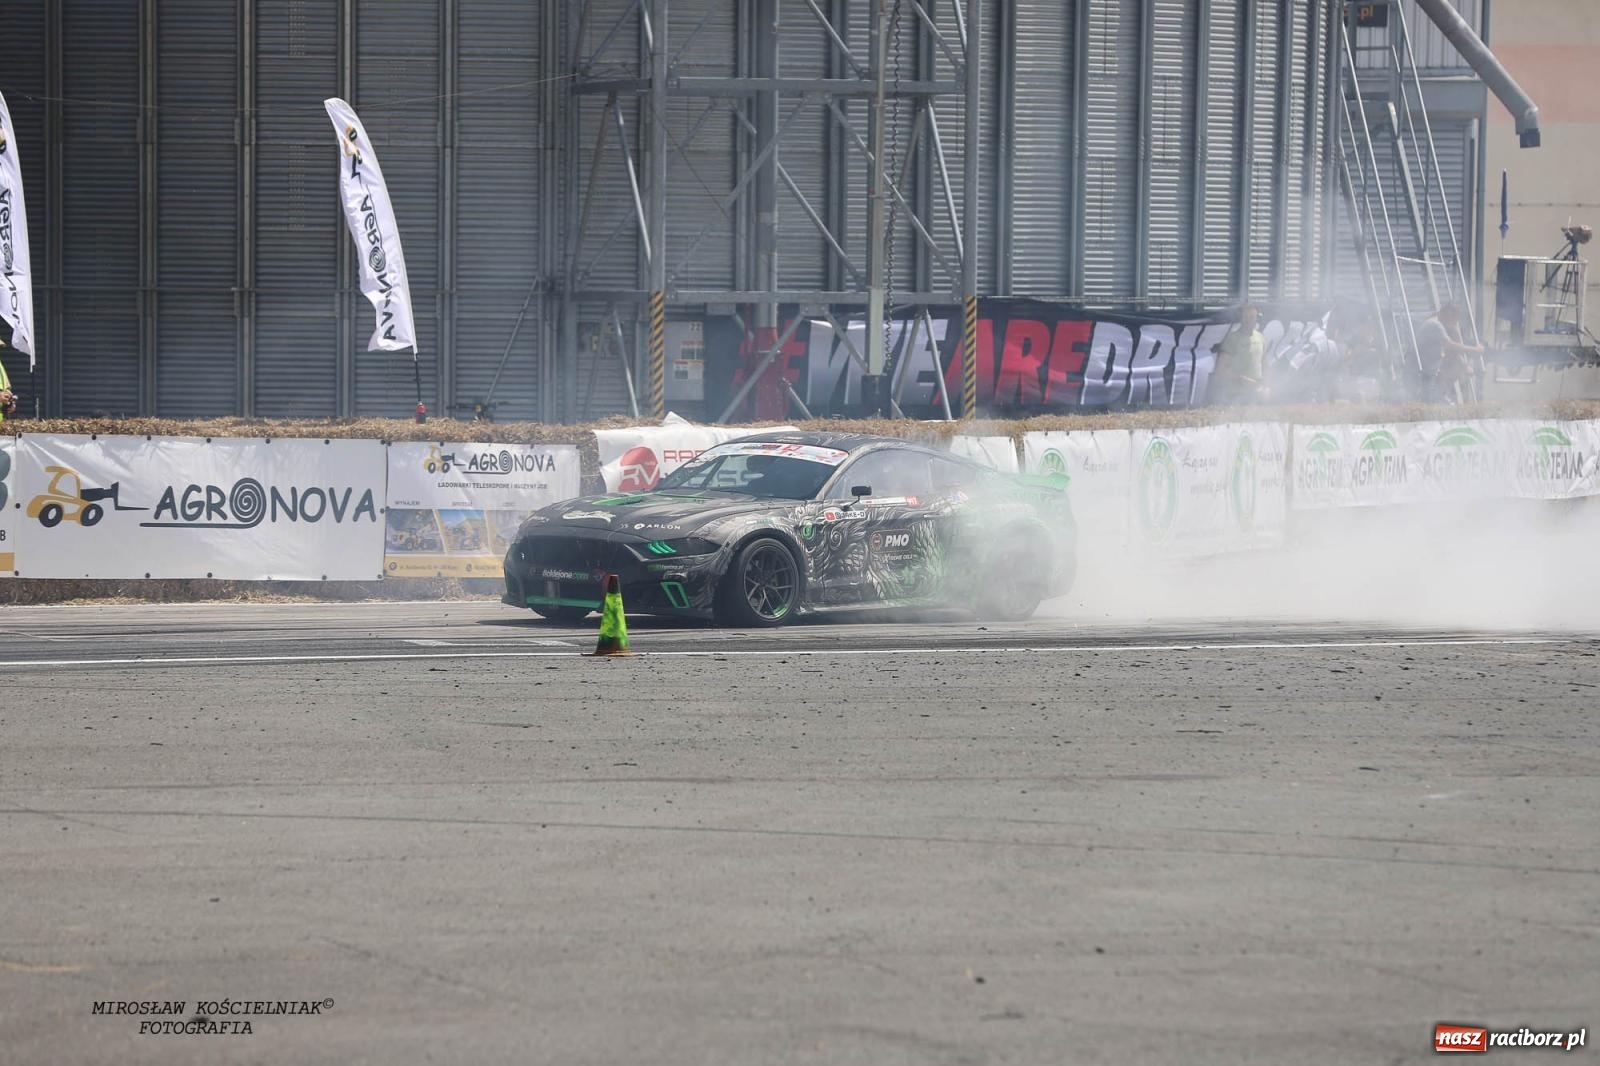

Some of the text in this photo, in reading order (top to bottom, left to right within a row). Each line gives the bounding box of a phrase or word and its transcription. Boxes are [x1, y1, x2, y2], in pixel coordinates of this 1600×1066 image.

[468, 450, 556, 472] AGRONOVA
[154, 477, 377, 524] AGRONOVA
[884, 534, 910, 548] PMO
